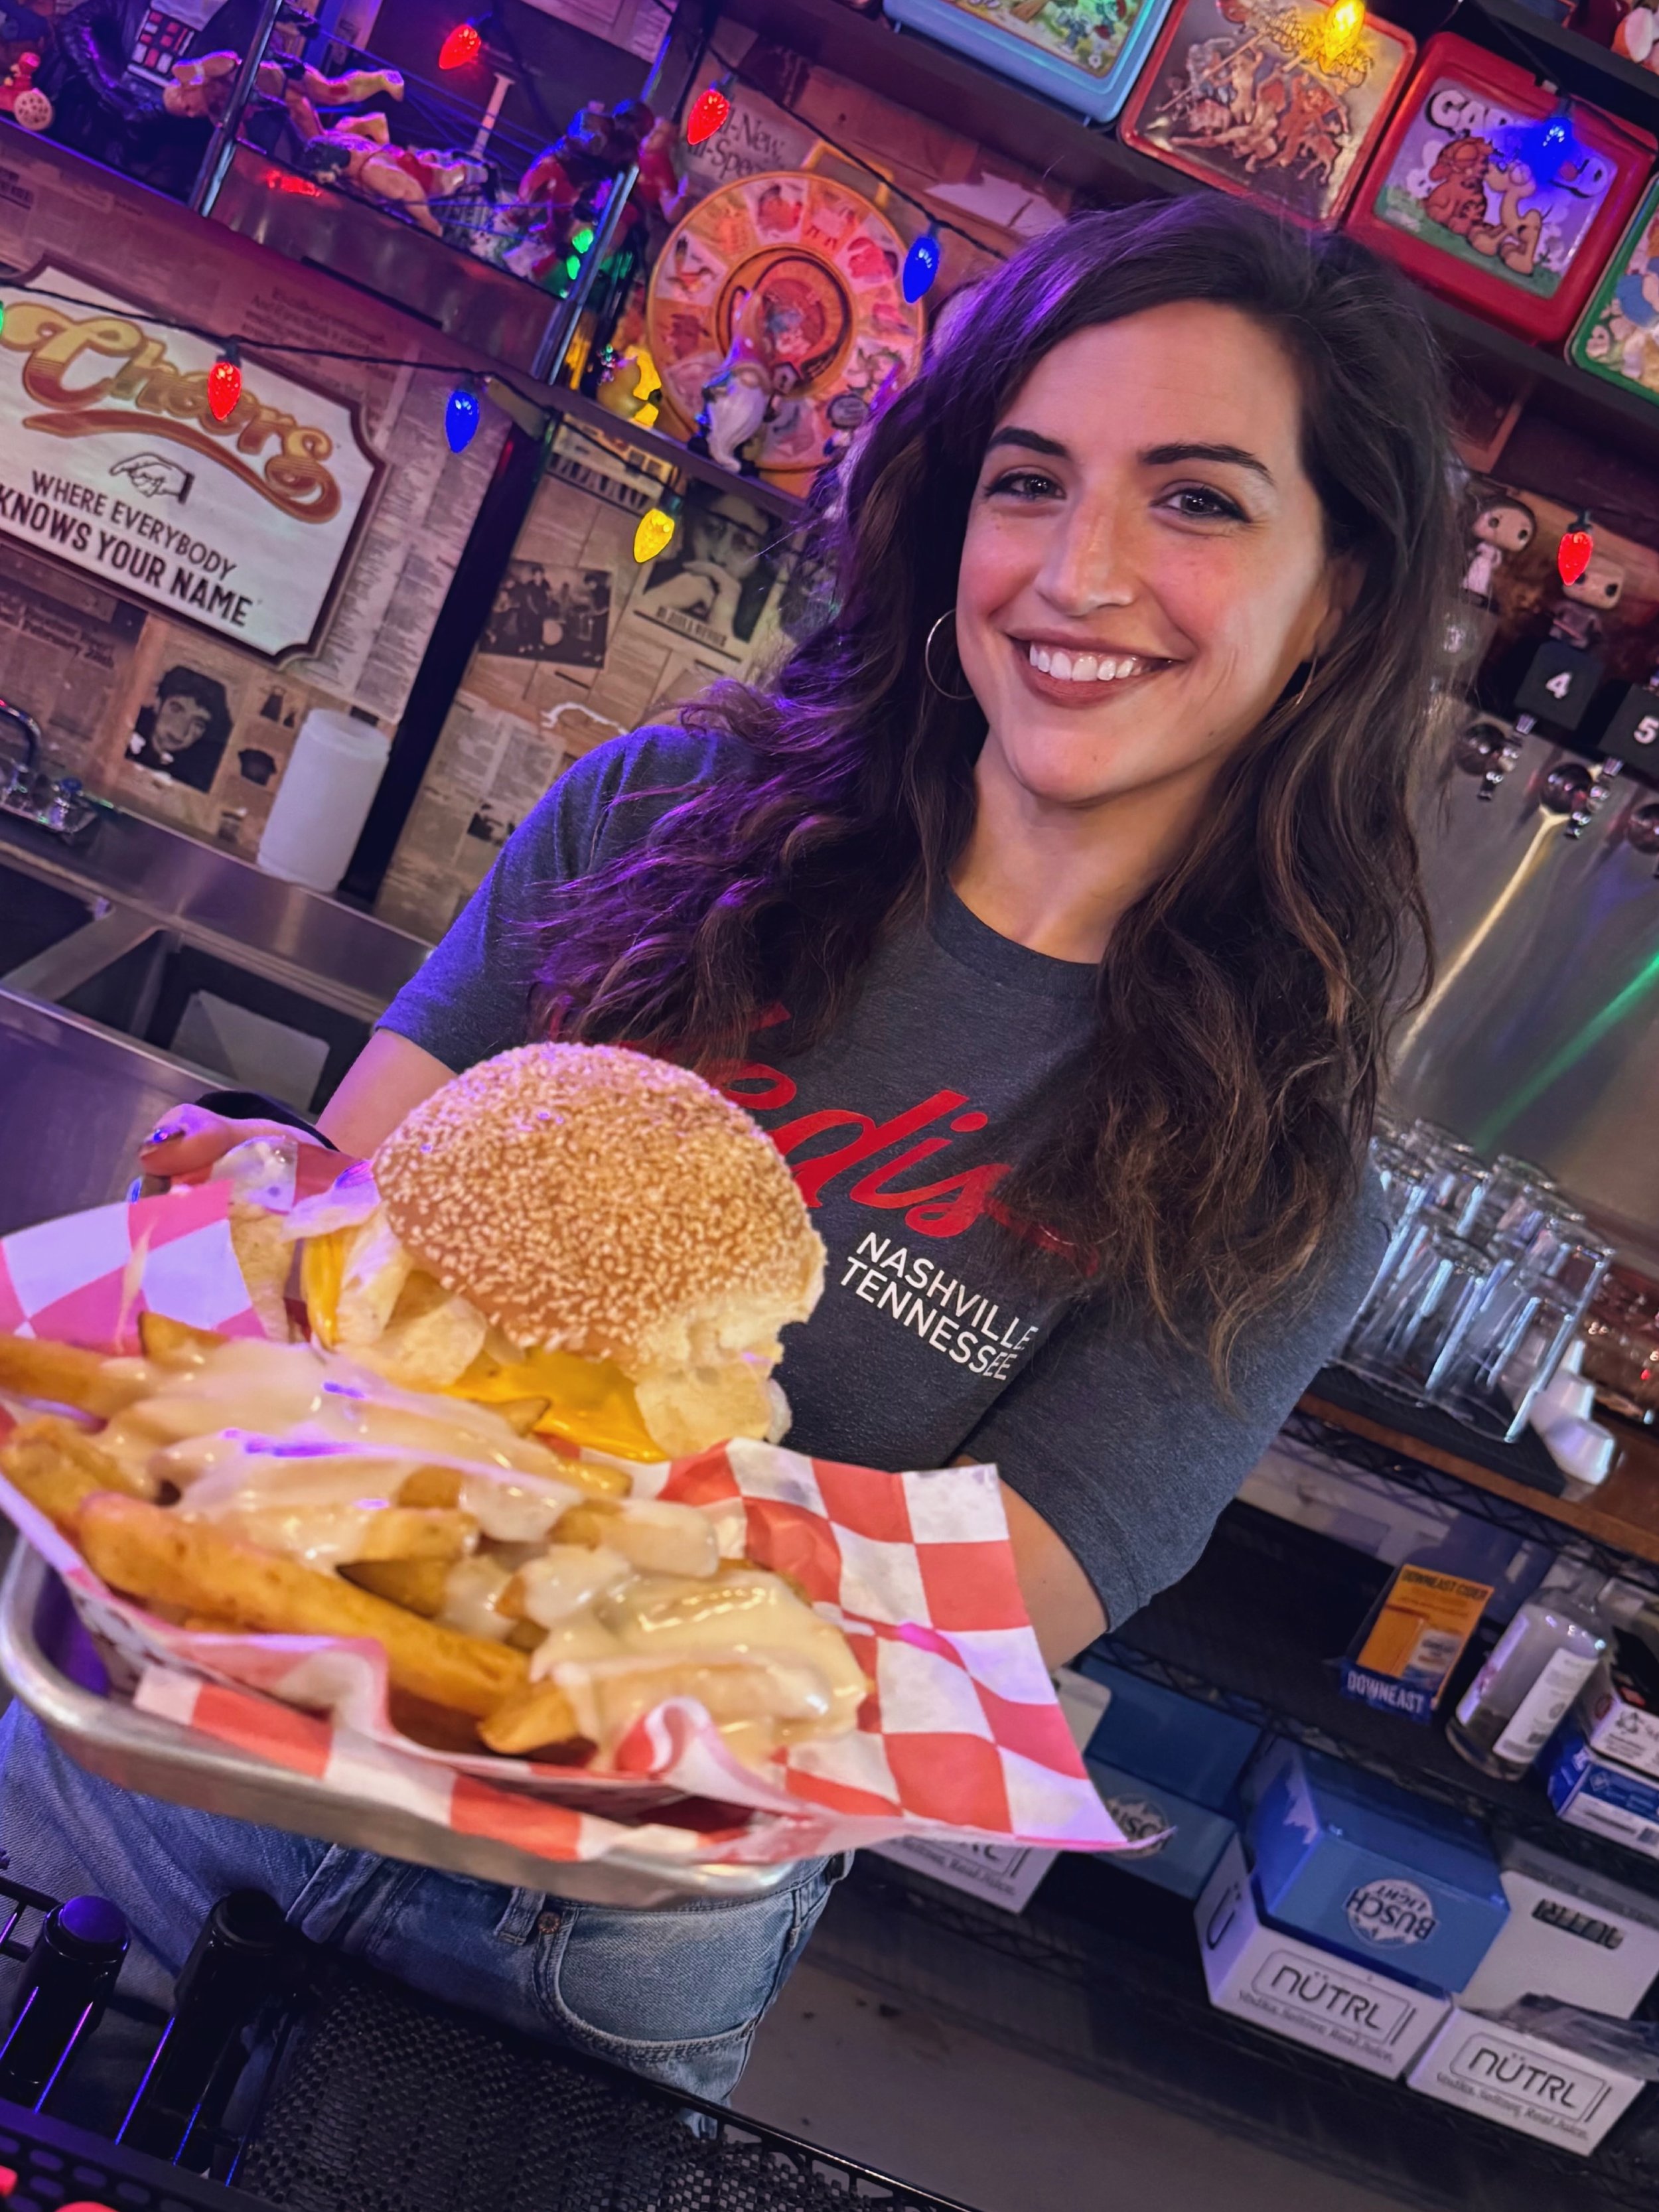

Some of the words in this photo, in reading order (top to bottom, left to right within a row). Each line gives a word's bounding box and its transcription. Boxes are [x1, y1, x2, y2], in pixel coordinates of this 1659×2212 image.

[32, 470, 109, 517] WHERE
[110, 500, 237, 581] EVERYBODY
[0, 484, 92, 552] KNOWS
[97, 530, 167, 589] YOUR
[169, 567, 253, 627] NAME
[1546, 672, 1572, 699] 4
[1633, 715, 1659, 745] 5
[840, 1256, 1017, 1381] TENNESSEE
[856, 1232, 1039, 1351] NASHVILLE
[1346, 1670, 1425, 1714] DOWNEAST
[1345, 1887, 1437, 1941] BUSCH
[1376, 1885, 1427, 1912] LIGHT
